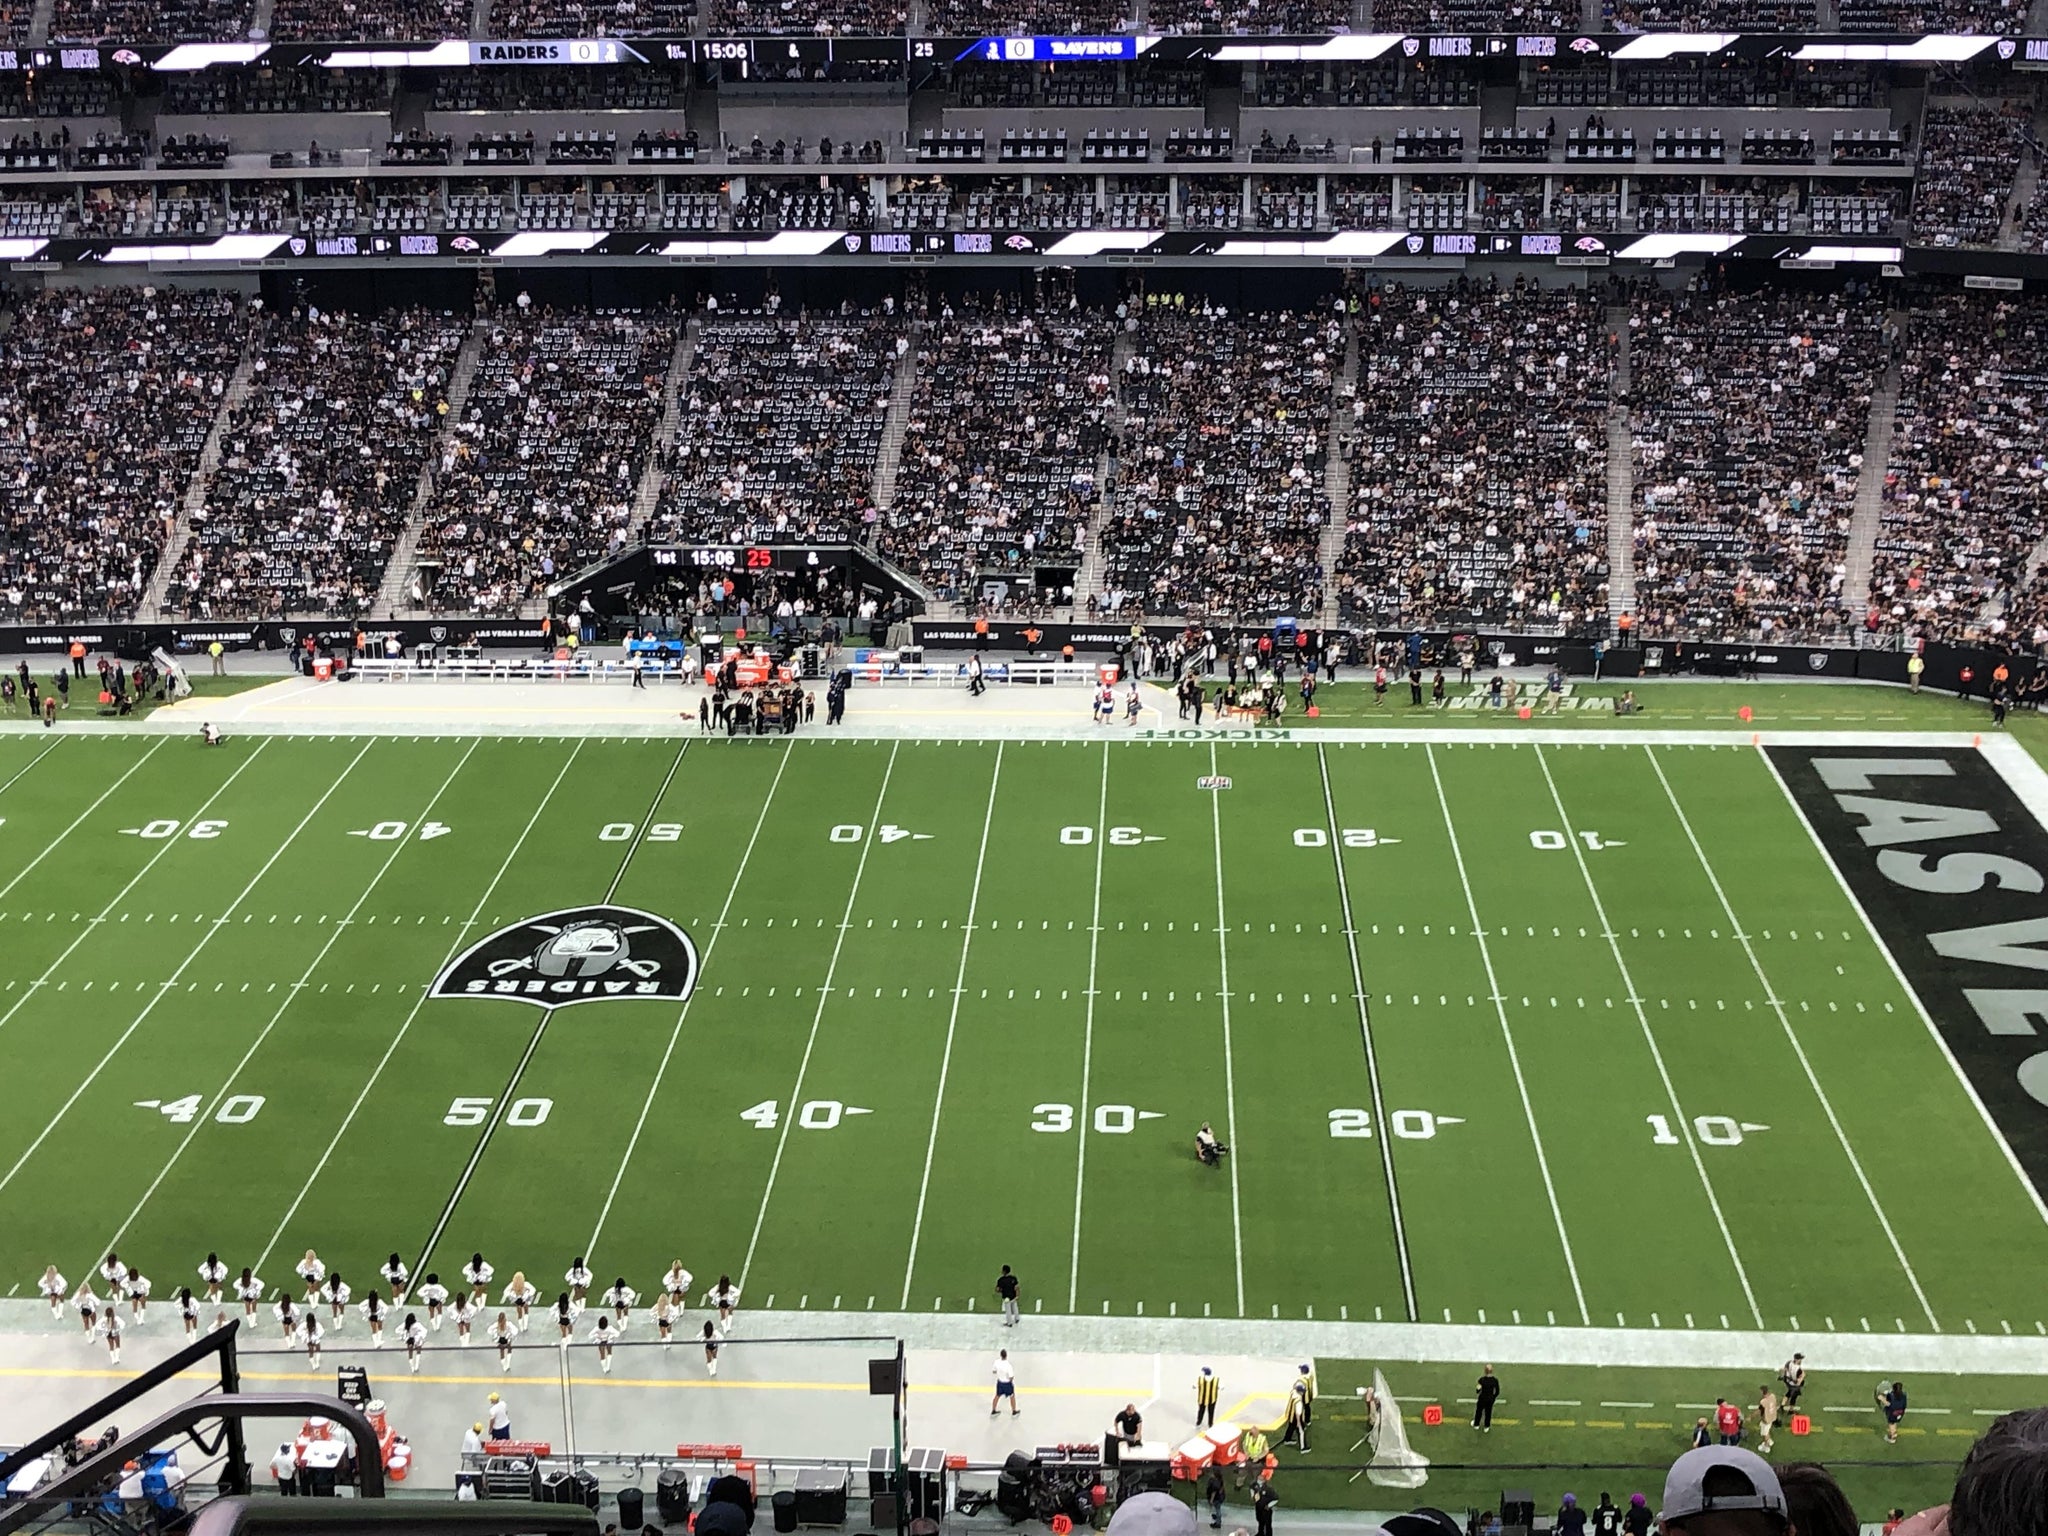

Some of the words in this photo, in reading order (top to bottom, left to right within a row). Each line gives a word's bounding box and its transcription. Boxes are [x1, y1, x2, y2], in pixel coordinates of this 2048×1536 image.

[479, 45, 559, 60] RAIDERS
[579, 45, 590, 59] 0
[703, 43, 748, 59] 15:06
[789, 43, 799, 57] &
[915, 42, 933, 57] 25
[1014, 42, 1026, 56] 0
[1050, 42, 1123, 57] RAVENS
[1429, 38, 1472, 56] RAIDERS
[870, 234, 912, 253] RAIDERS
[1433, 235, 1476, 254] RAIDERS
[653, 551, 677, 565] 1st
[691, 551, 736, 566] 15:06
[747, 549, 772, 566] 25
[807, 551, 819, 565] &
[26, 636, 41, 644] LAS
[475, 630, 488, 639] LAS
[490, 630, 514, 639] VEGAS
[924, 631, 938, 639] LAS
[939, 631, 965, 639] VEGAS
[1071, 634, 1084, 642] LAS
[1086, 634, 1112, 642] VEGAS
[1534, 646, 1550, 654] LAS
[1135, 729, 1291, 739] KICKOFF
[140, 819, 229, 839] 30
[369, 820, 452, 841] 40
[598, 822, 685, 842] 50
[829, 824, 911, 843] 40
[1809, 757, 2047, 894] LAS
[1059, 826, 1142, 845] 30
[1293, 828, 1378, 848] 20
[1529, 830, 1604, 850] 10
[464, 979, 661, 994] RAIDERS
[160, 1095, 267, 1126] 40
[443, 1098, 553, 1127] 50
[739, 1100, 841, 1130] 40
[1031, 1103, 1136, 1133] 30
[1328, 1109, 1437, 1140] 20
[1645, 1114, 1743, 1147] 10
[1427, 1409, 1441, 1423] 20
[1796, 1419, 1807, 1432] 10
[1227, 1441, 1238, 1458] G
[1054, 1518, 1068, 1533] 30
[1604, 1516, 1612, 1530] 8
